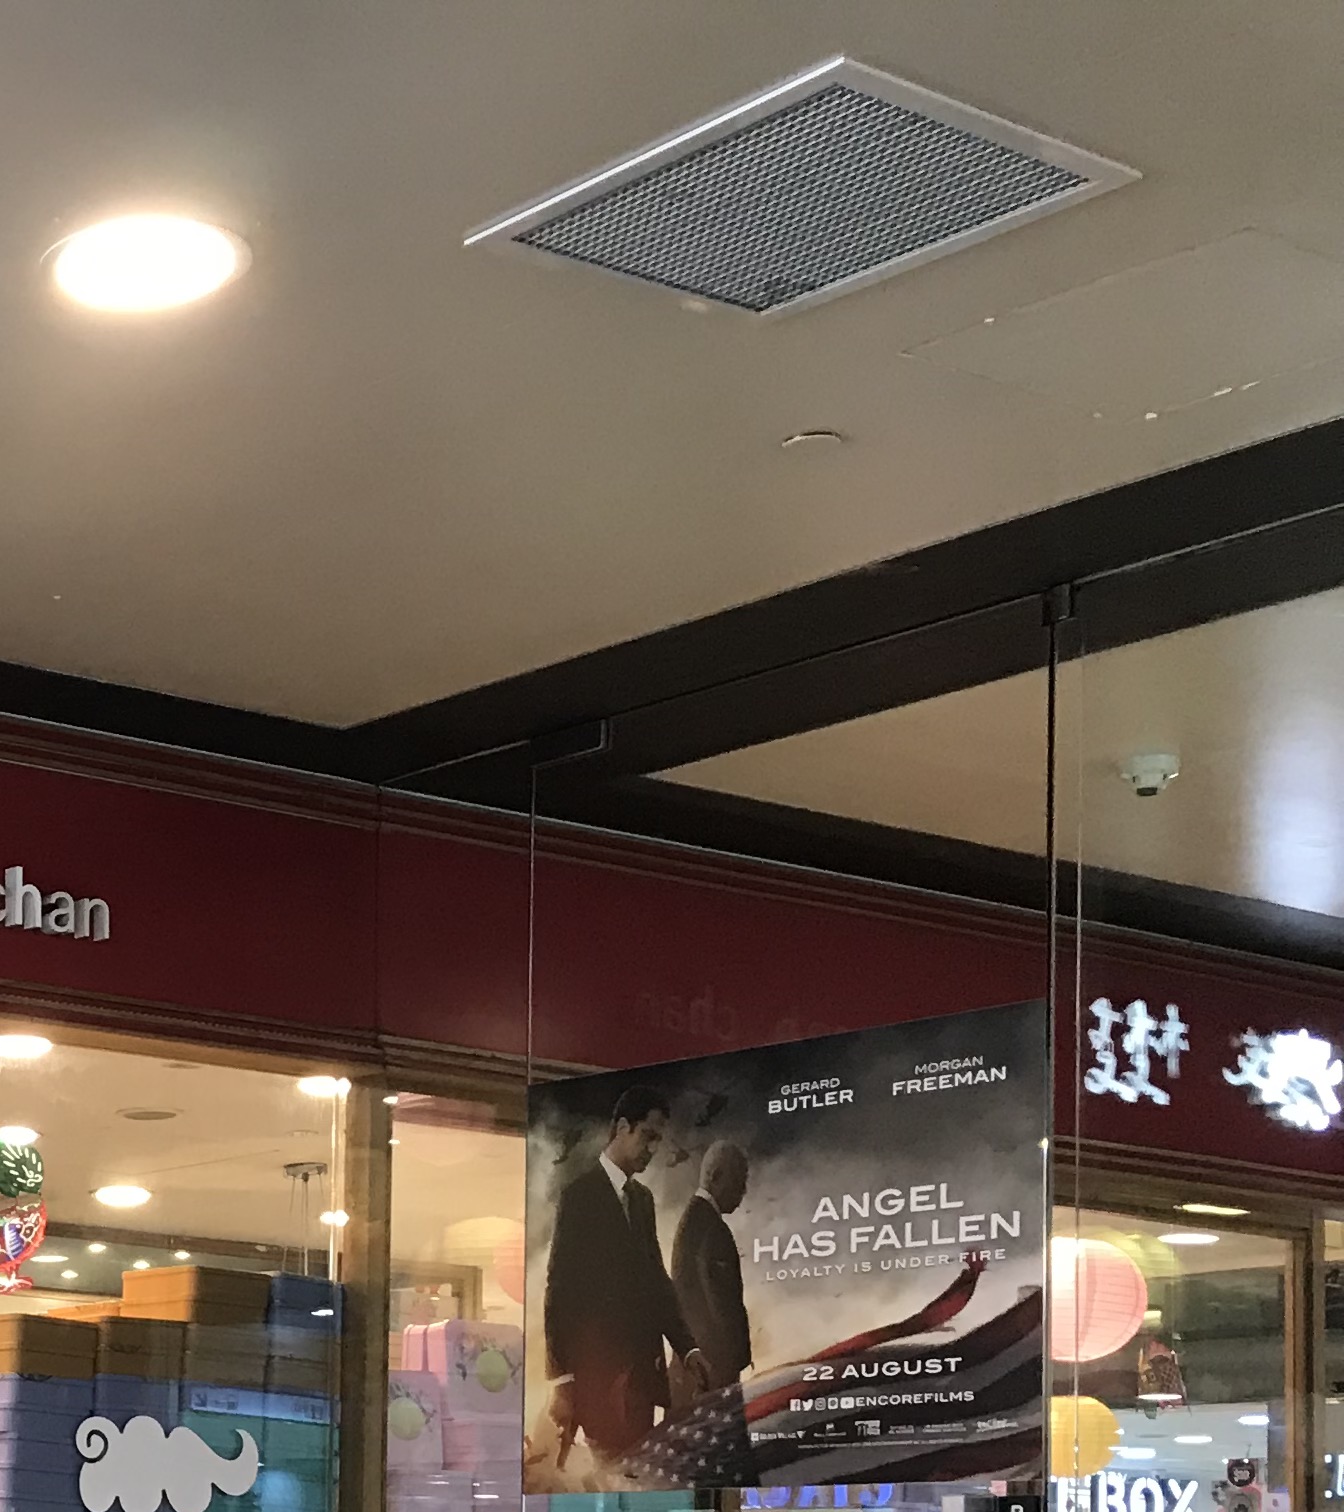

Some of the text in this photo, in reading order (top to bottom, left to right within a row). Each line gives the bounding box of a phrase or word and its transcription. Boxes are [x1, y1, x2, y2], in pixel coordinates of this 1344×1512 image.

[768, 1065, 1007, 1114] BUTLER FREEMAN
[780, 1055, 984, 1096] GERARD MORGAN
[811, 1182, 964, 1224] ANGEL
[753, 1210, 1021, 1263] HAS FALLEN
[766, 1248, 1007, 1282] LOYALTY IS UNDER FIRE
[802, 1357, 963, 1381] 22 AUGUST
[855, 1390, 975, 1407] ENCOREFILMS
